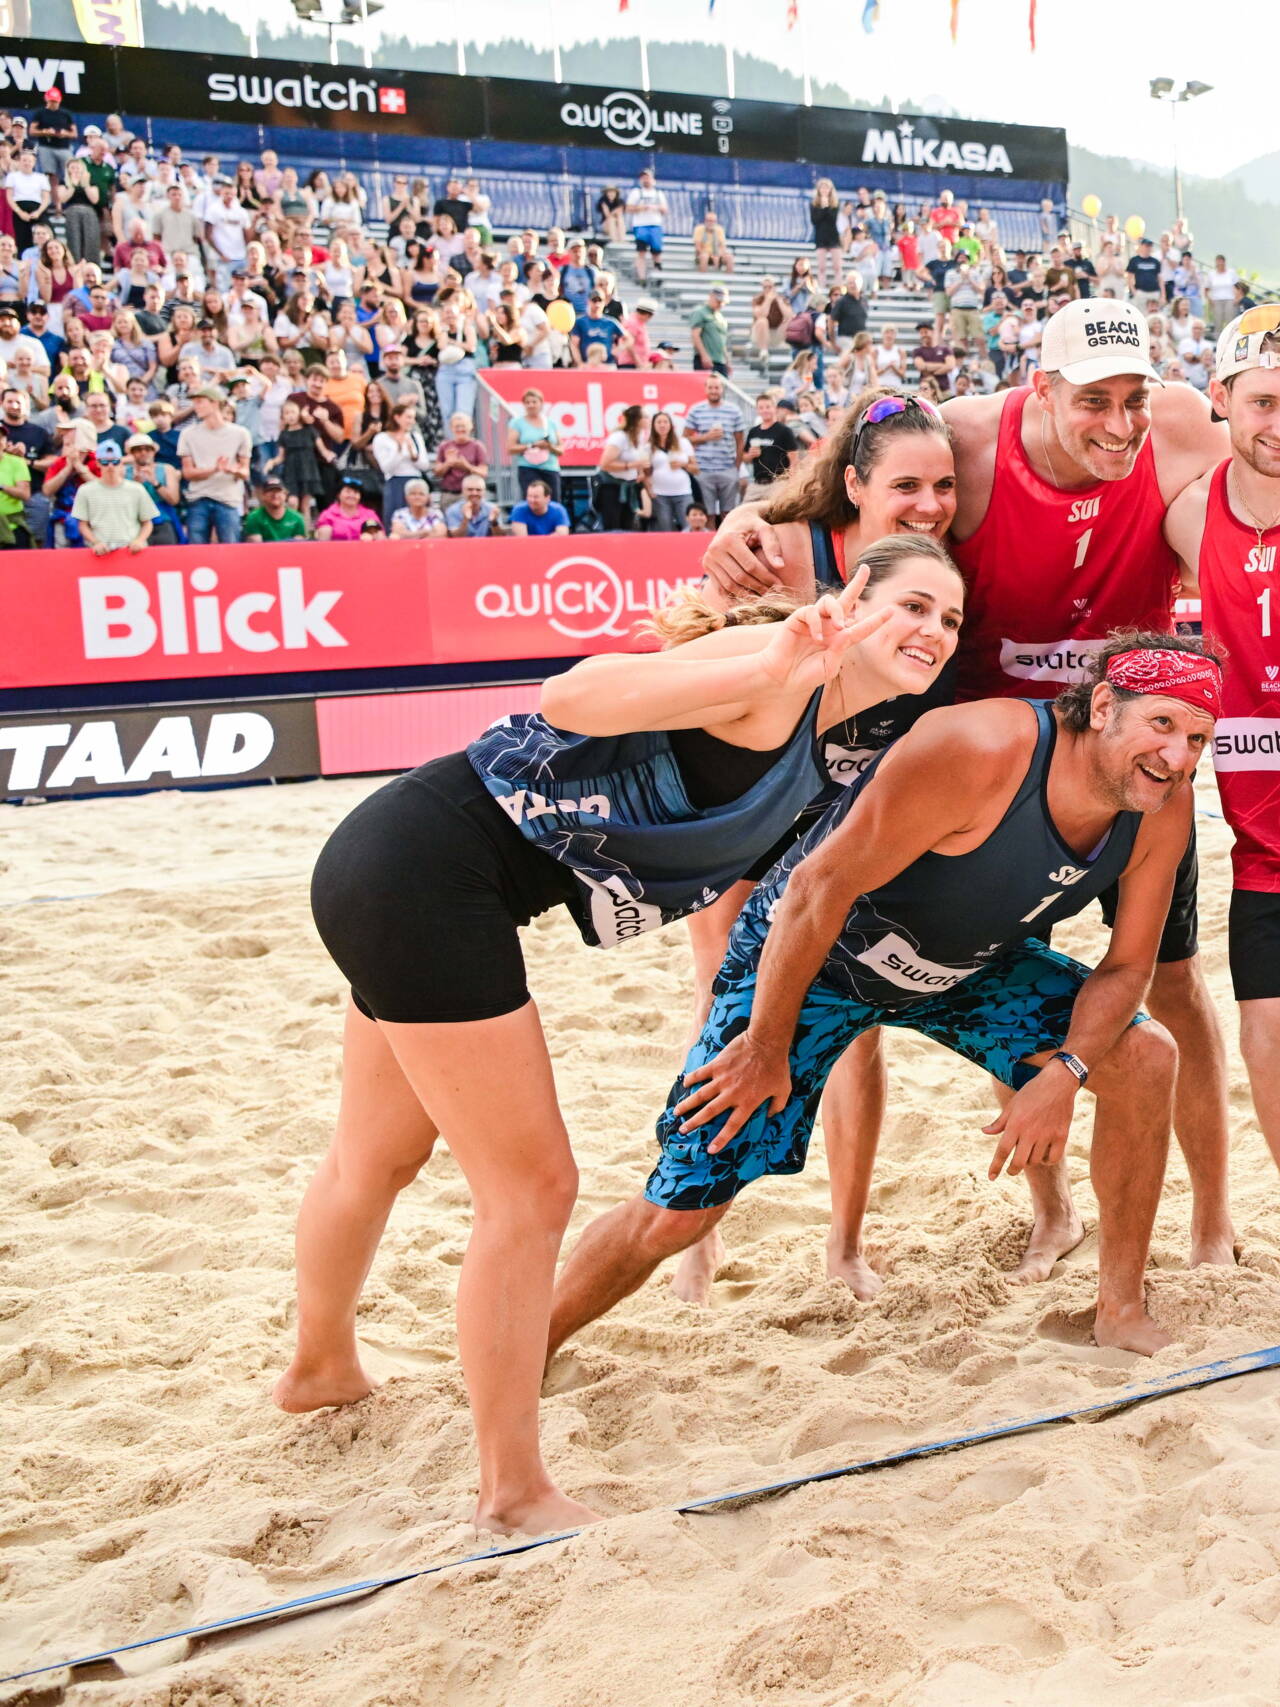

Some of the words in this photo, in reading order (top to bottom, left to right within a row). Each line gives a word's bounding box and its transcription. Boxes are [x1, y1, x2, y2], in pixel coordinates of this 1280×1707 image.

[207, 73, 377, 113] swatch
[560, 91, 703, 147] QUICKLINE
[1084, 321, 1139, 337] BEACH
[1087, 335, 1140, 347] GSTAAD
[1067, 496, 1102, 522] SUI
[1073, 528, 1093, 570] 1
[1244, 546, 1277, 573] SUI
[78, 566, 349, 660] Blick
[475, 556, 703, 639] QUICKLIN
[1256, 588, 1271, 638] 1
[0, 712, 275, 791] TAAD
[1048, 865, 1089, 886] SU
[1019, 890, 1065, 923] 1
[881, 953, 960, 986] swat
